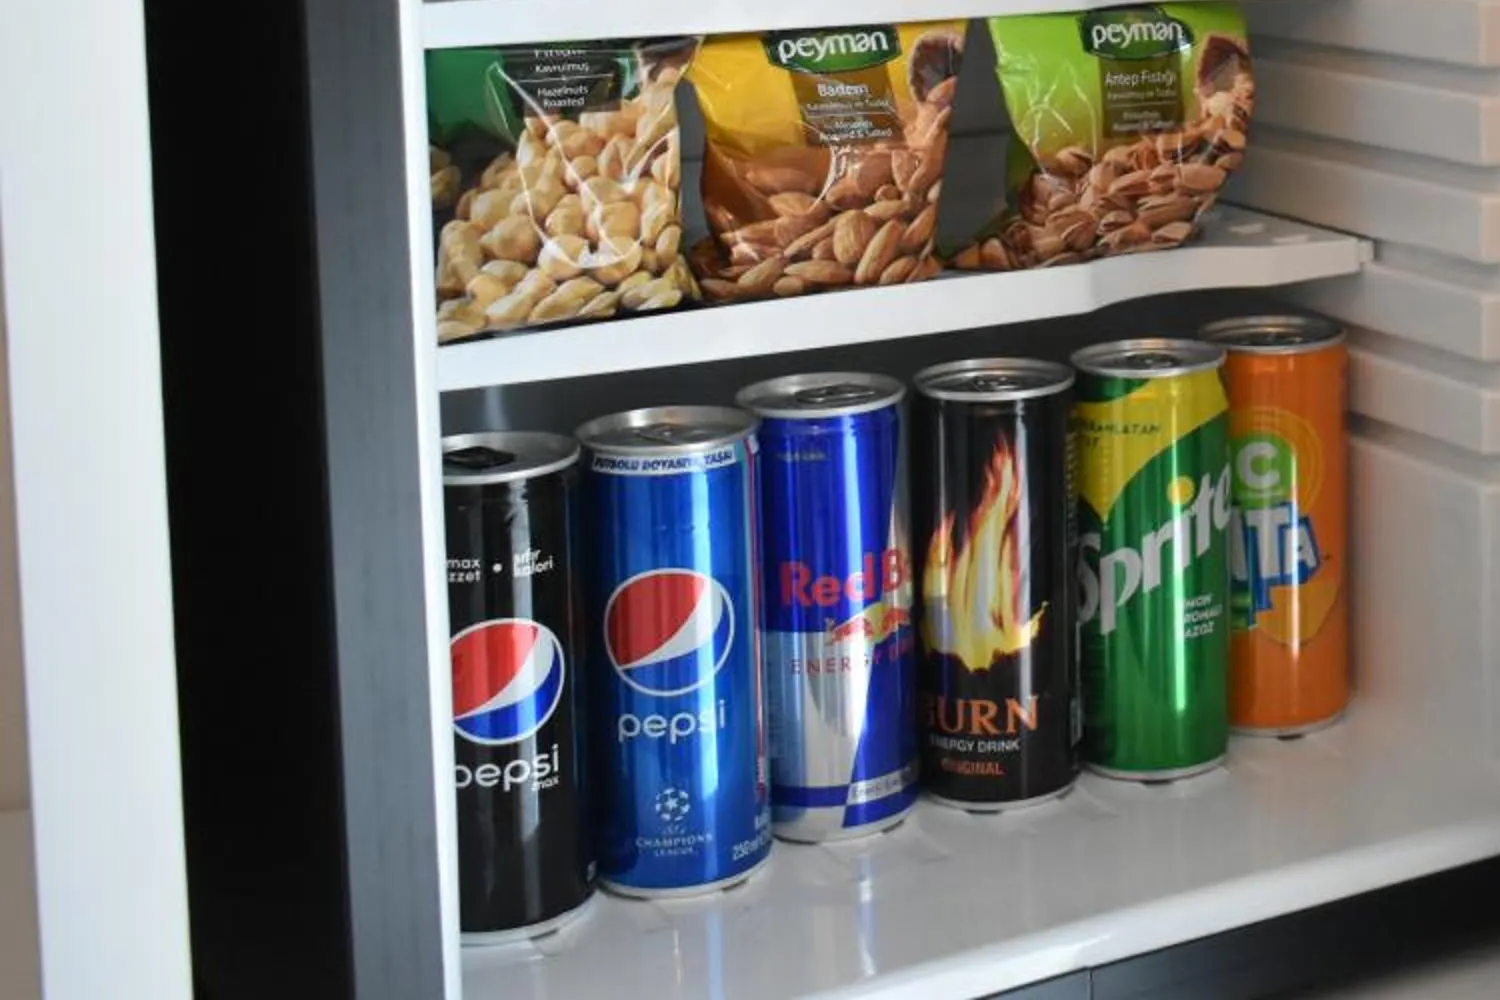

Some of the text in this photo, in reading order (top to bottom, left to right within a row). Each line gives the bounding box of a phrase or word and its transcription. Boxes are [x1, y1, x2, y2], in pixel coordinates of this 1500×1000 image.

[777, 30, 889, 64] peyman
[1091, 20, 1184, 49] peyman
[1077, 462, 1231, 636] Sprite
[447, 570, 481, 582] zzet
[779, 551, 876, 608] Red
[790, 650, 882, 675] ENERY
[618, 699, 726, 744] pepsi
[976, 738, 1021, 754] DRINK
